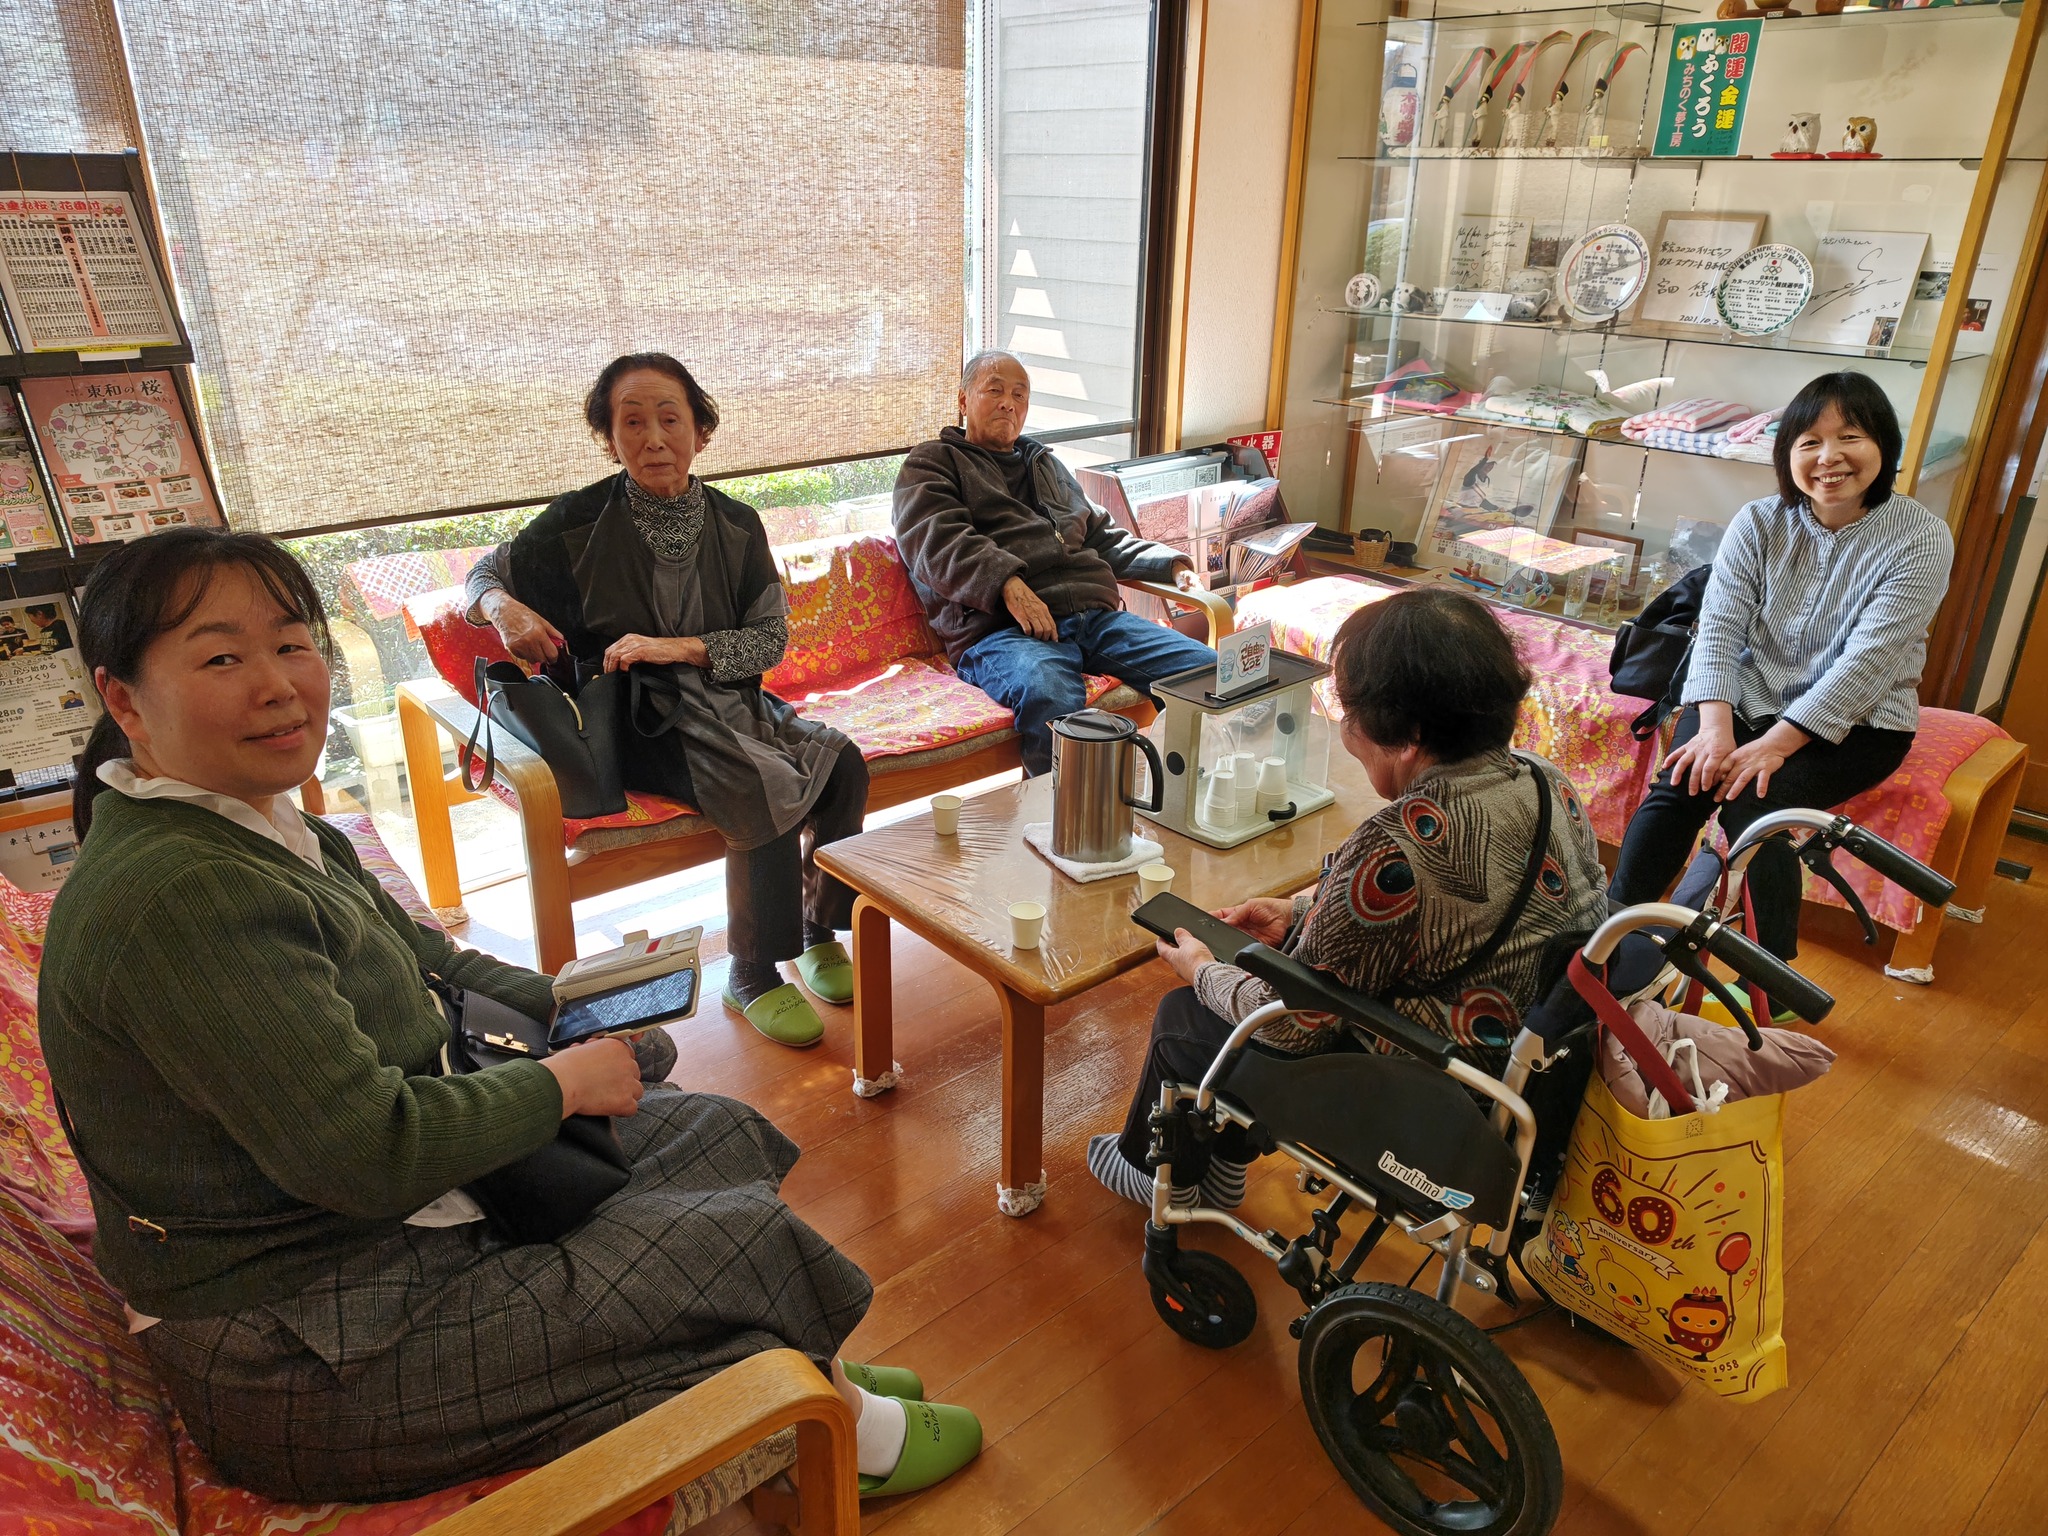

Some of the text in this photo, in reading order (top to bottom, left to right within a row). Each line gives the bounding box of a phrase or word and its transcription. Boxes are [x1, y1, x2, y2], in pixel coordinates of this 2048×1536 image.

[1692, 54, 1719, 138] ふくろう
[1715, 32, 1750, 129] 開運・金運
[1669, 63, 1696, 147] みちのく夢工房
[1744, 245, 1773, 259] OLYMPIC
[86, 379, 163, 398] 東和の桜
[1241, 642, 1265, 660] ご自由に
[1242, 654, 1263, 672] どうぞ
[1381, 1152, 1440, 1198] Carutima
[1599, 1226, 1657, 1261] anniversary
[1547, 1275, 1575, 1299] Origin
[1595, 1309, 1630, 1333] Instant
[1676, 1357, 1707, 1374] Since
[1713, 1359, 1740, 1374] 1958
